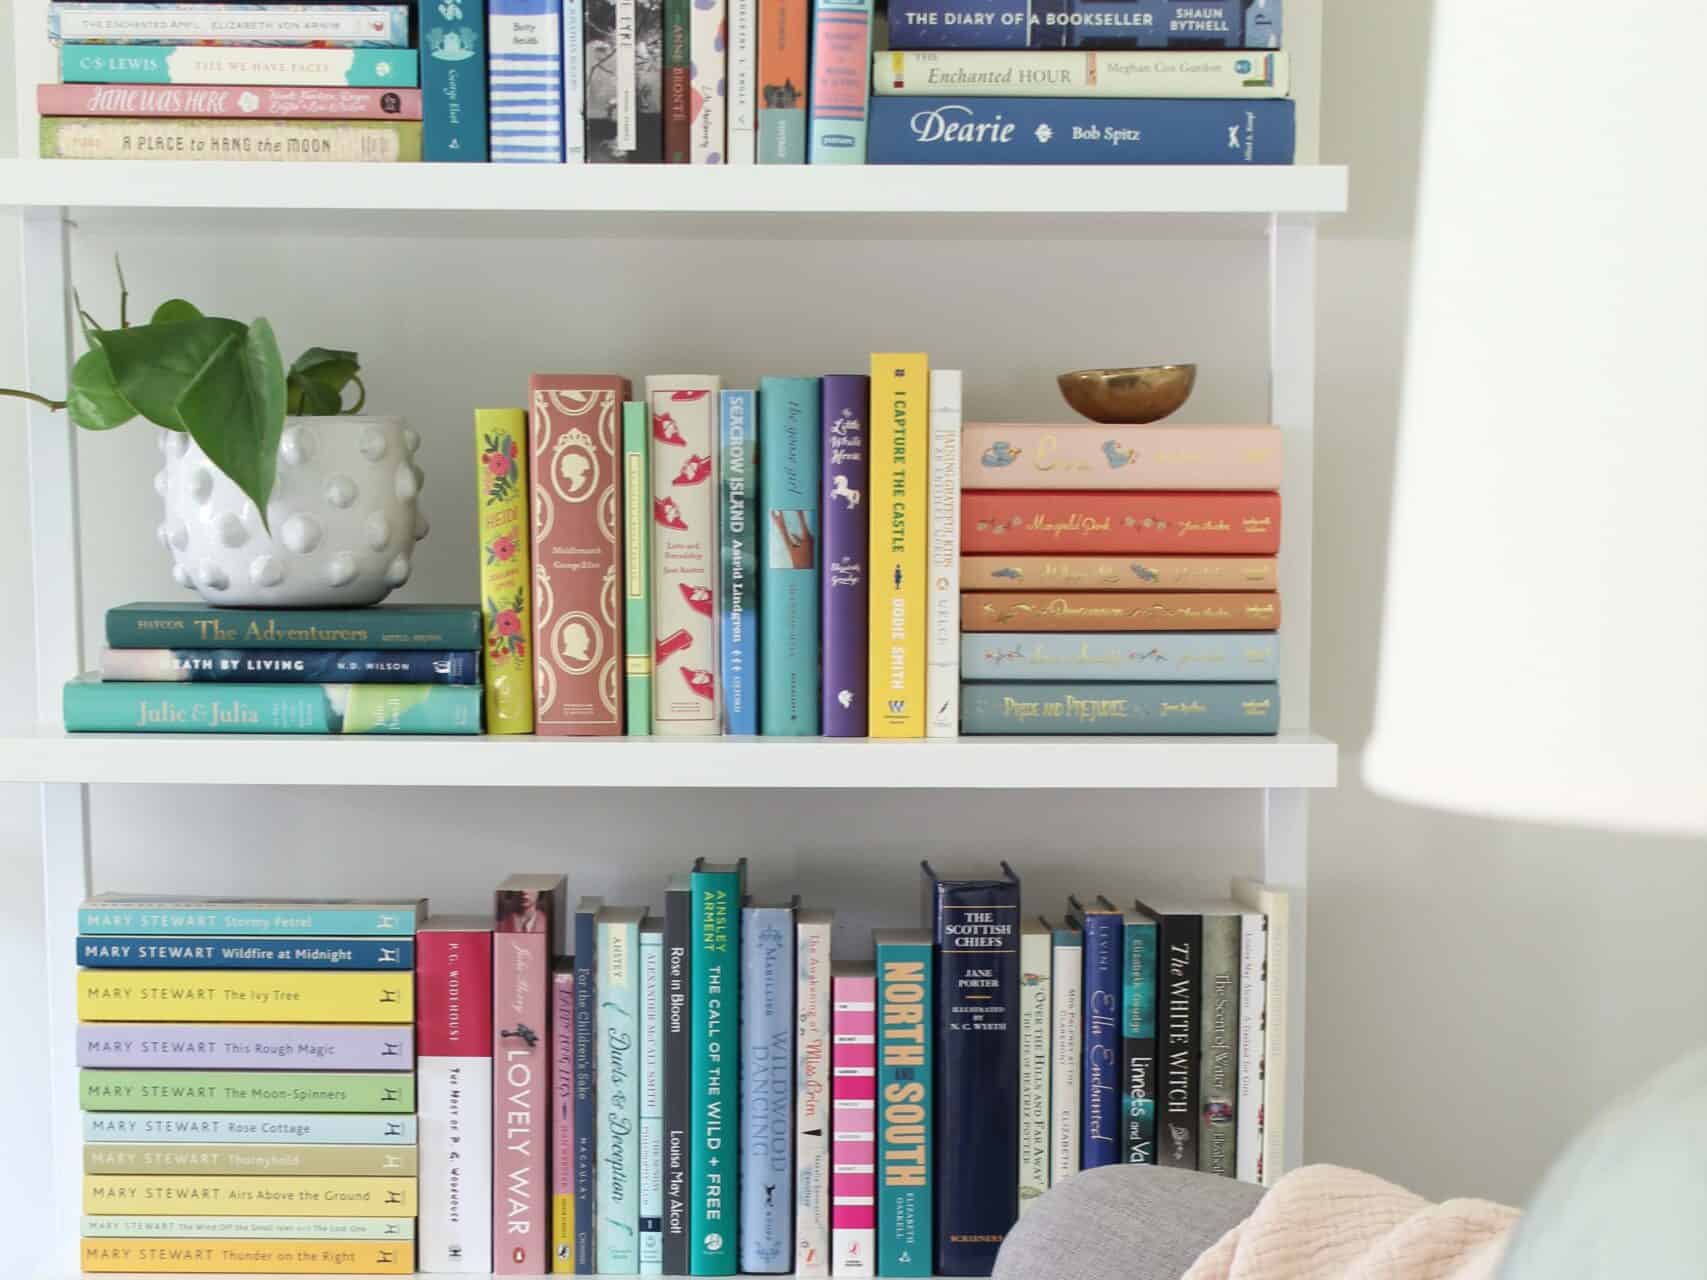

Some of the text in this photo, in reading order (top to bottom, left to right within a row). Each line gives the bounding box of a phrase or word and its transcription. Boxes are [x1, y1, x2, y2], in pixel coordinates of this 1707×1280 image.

[905, 12, 1152, 26] THE DIARY OF A BOOKSELLER
[1176, 8, 1223, 19] SHAUN
[1169, 20, 1229, 32] BYTHELL
[108, 57, 159, 70] LEWIS
[928, 66, 1071, 85] Enchanted HOUR
[910, 105, 1016, 143] Dearie
[1072, 126, 1142, 146] Bob Spitz
[122, 136, 331, 153] A PLACE to HANG the MOON
[892, 400, 906, 464] CAPTURE
[730, 396, 744, 532] SEACROW ISLAND
[892, 471, 906, 497] THE
[892, 502, 906, 552] CASTLE
[730, 540, 744, 642] Astrid Lindgren
[194, 620, 238, 642] The
[244, 620, 368, 642] Adventurers
[892, 598, 906, 690] DODIE SMITH
[220, 659, 305, 672] BY LIVING
[88, 915, 217, 927] MARY STEWART
[704, 890, 714, 952] ARMENT
[716, 890, 728, 952] AINSLEY
[944, 924, 1012, 934] SCOTTISH
[964, 912, 993, 922] THE
[954, 937, 1002, 947] CHIEFS
[84, 946, 352, 964] MARY STEWART Wildfire at Midnight
[88, 987, 300, 1004] MARY STEWART The Ivy Tree
[670, 946, 684, 1033] Rose in Bloom
[884, 962, 926, 1066] NORTH
[578, 968, 590, 1100] For the Children's Sake
[1168, 942, 1190, 1113] The WHITE WITCH
[88, 1040, 336, 1058] MARY STEWART This Rough Magic
[1090, 990, 1115, 1142] Ella Enchanted
[88, 1086, 348, 1102] MARY STEWART The Moon-Spinners
[706, 966, 722, 1220] THE CALL OF THE WILD + FREE
[1131, 1056, 1152, 1116] Linnets
[92, 1120, 311, 1137] MARY STEWART Rose Cottage
[886, 1082, 926, 1186] SOUTH
[1130, 1120, 1144, 1140] and
[507, 1050, 531, 1234] LOVELY WAR
[92, 1153, 219, 1166] MARY STEWART
[608, 1112, 633, 1204] Deception
[668, 1130, 684, 1234] Louisa May Alcott
[92, 1187, 371, 1202] MARY STEWART Airs Above the Ground
[895, 1197, 904, 1240] GASKELL
[905, 1192, 914, 1244] ELIZABETH
[86, 1248, 356, 1265] MARY STEWART Thunder on the Right
